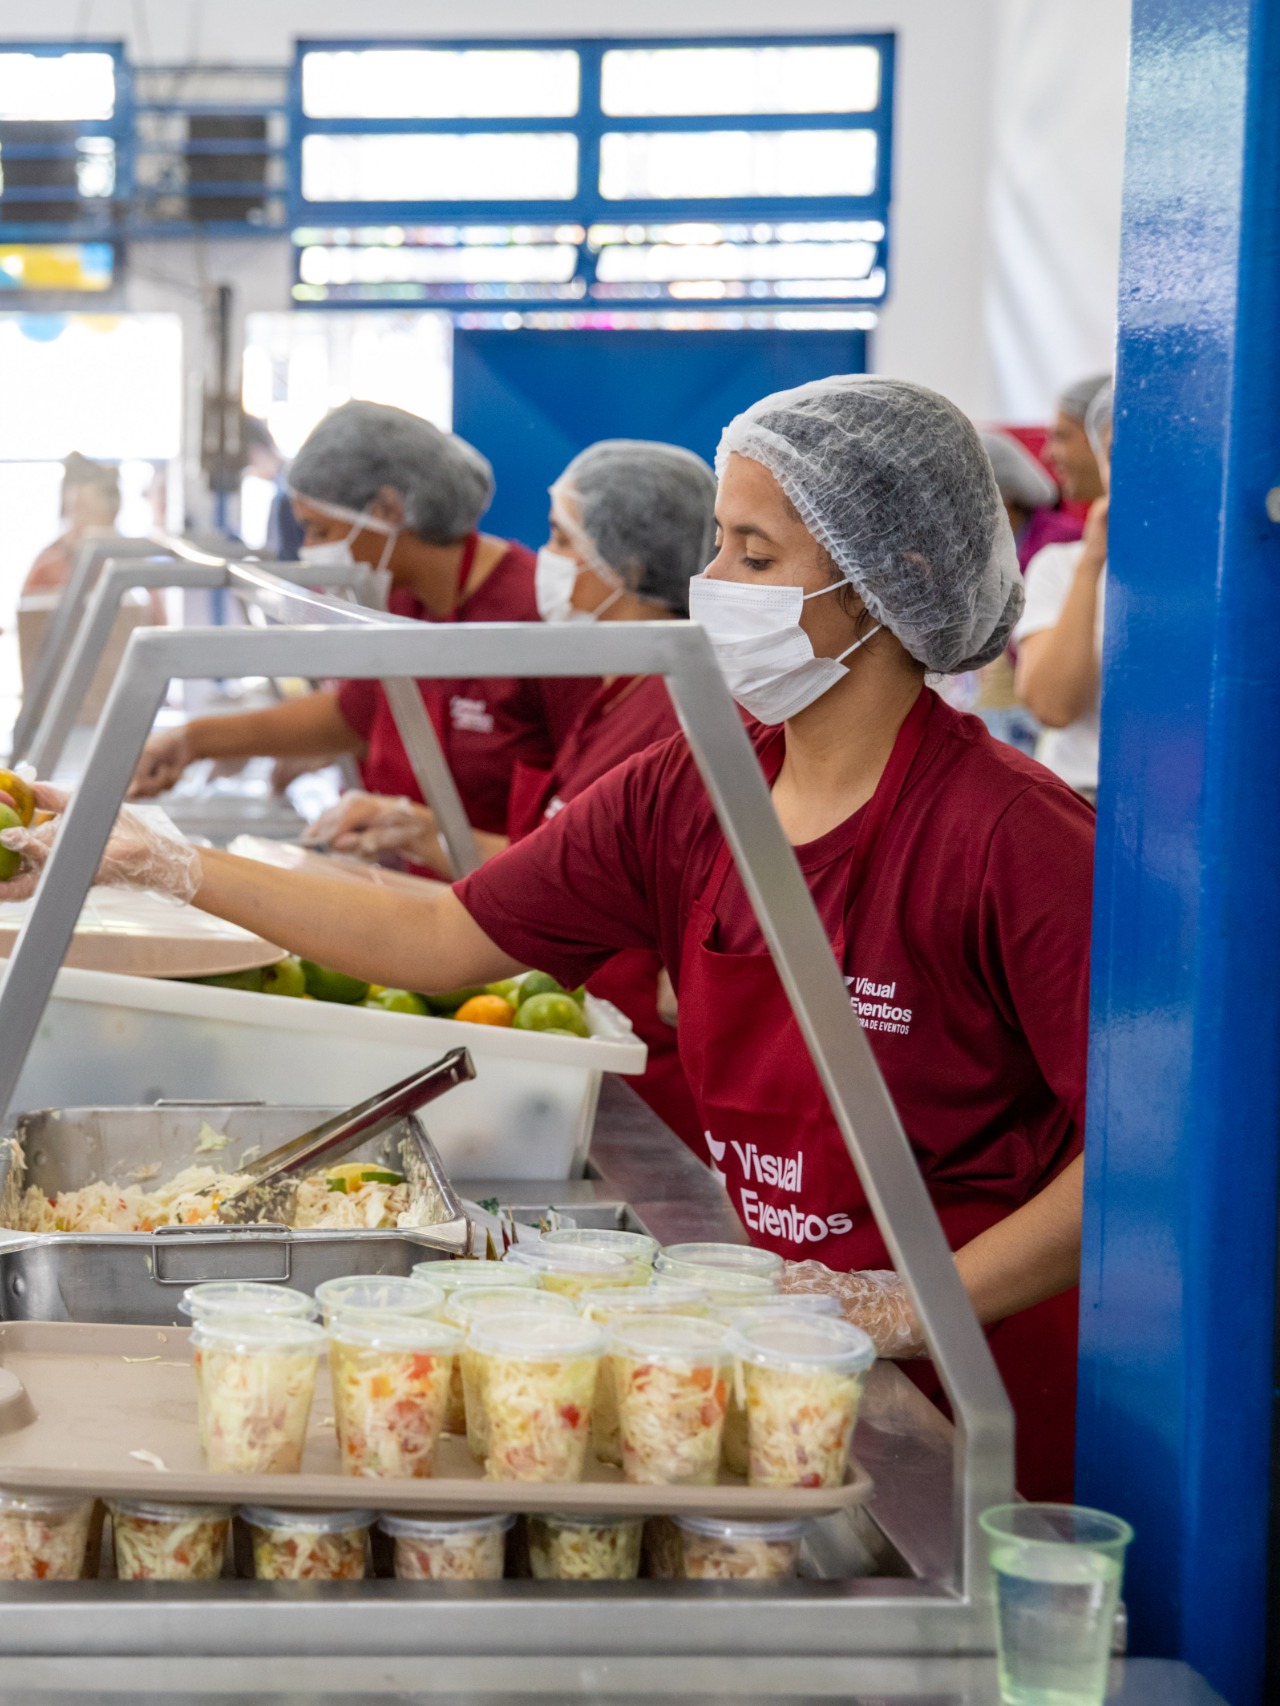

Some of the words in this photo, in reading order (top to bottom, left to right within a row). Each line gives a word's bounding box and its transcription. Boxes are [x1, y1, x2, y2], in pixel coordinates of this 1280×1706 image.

[855, 977, 896, 998] Visual
[850, 997, 912, 1022] Eventos
[869, 1019, 879, 1030] DE
[878, 1021, 910, 1035] EVENTOS
[730, 1140, 803, 1193] Visual
[740, 1187, 853, 1244] Eventos
